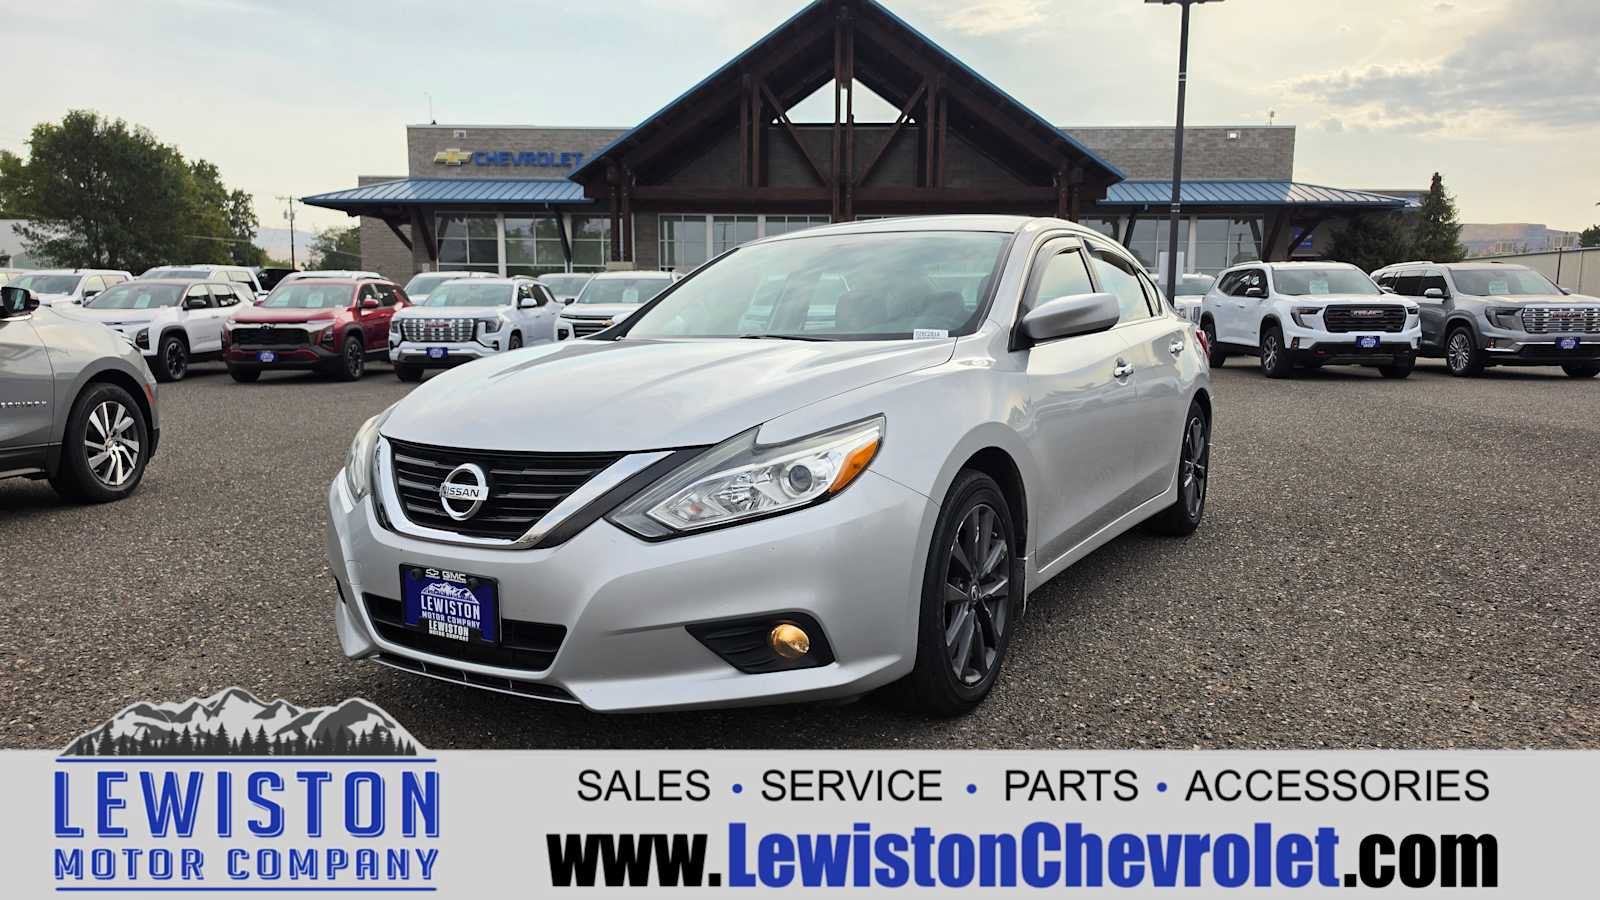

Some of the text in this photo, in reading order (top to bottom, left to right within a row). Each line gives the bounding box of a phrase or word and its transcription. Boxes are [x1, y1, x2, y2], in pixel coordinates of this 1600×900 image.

[474, 151, 584, 168] CHEVROLET
[441, 485, 480, 498] NISSAN
[442, 571, 467, 582] GMC
[420, 594, 481, 620] LEWISTON
[421, 610, 481, 629] MOTOR COMPANY
[428, 620, 469, 637] LEWISTON
